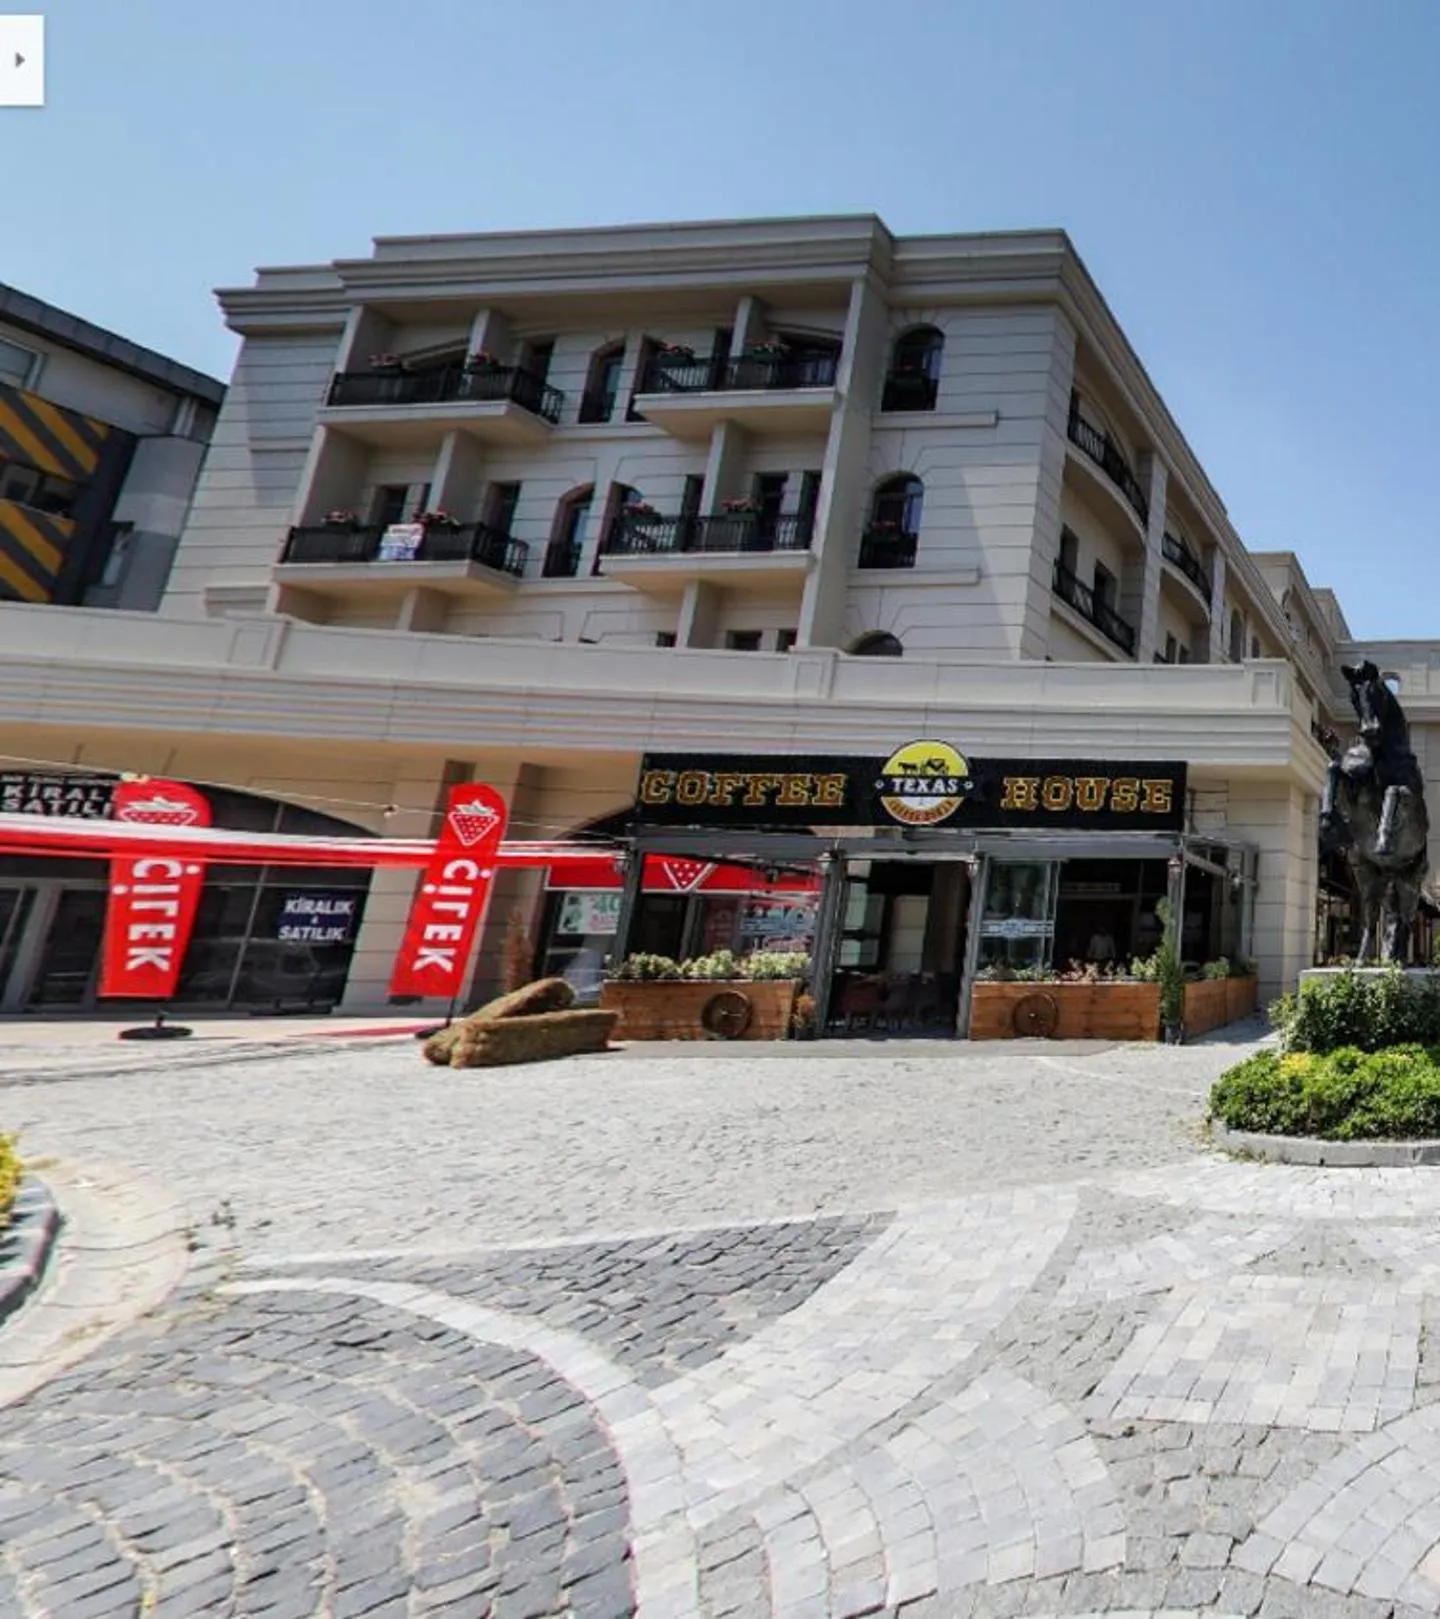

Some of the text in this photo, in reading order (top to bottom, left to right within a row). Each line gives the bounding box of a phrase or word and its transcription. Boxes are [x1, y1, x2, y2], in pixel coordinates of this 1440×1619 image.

[641, 770, 848, 806] COFFEE
[1000, 776, 1173, 813] HOUSE
[891, 777, 959, 794] TEXAS
[277, 924, 347, 942] SATILIK
